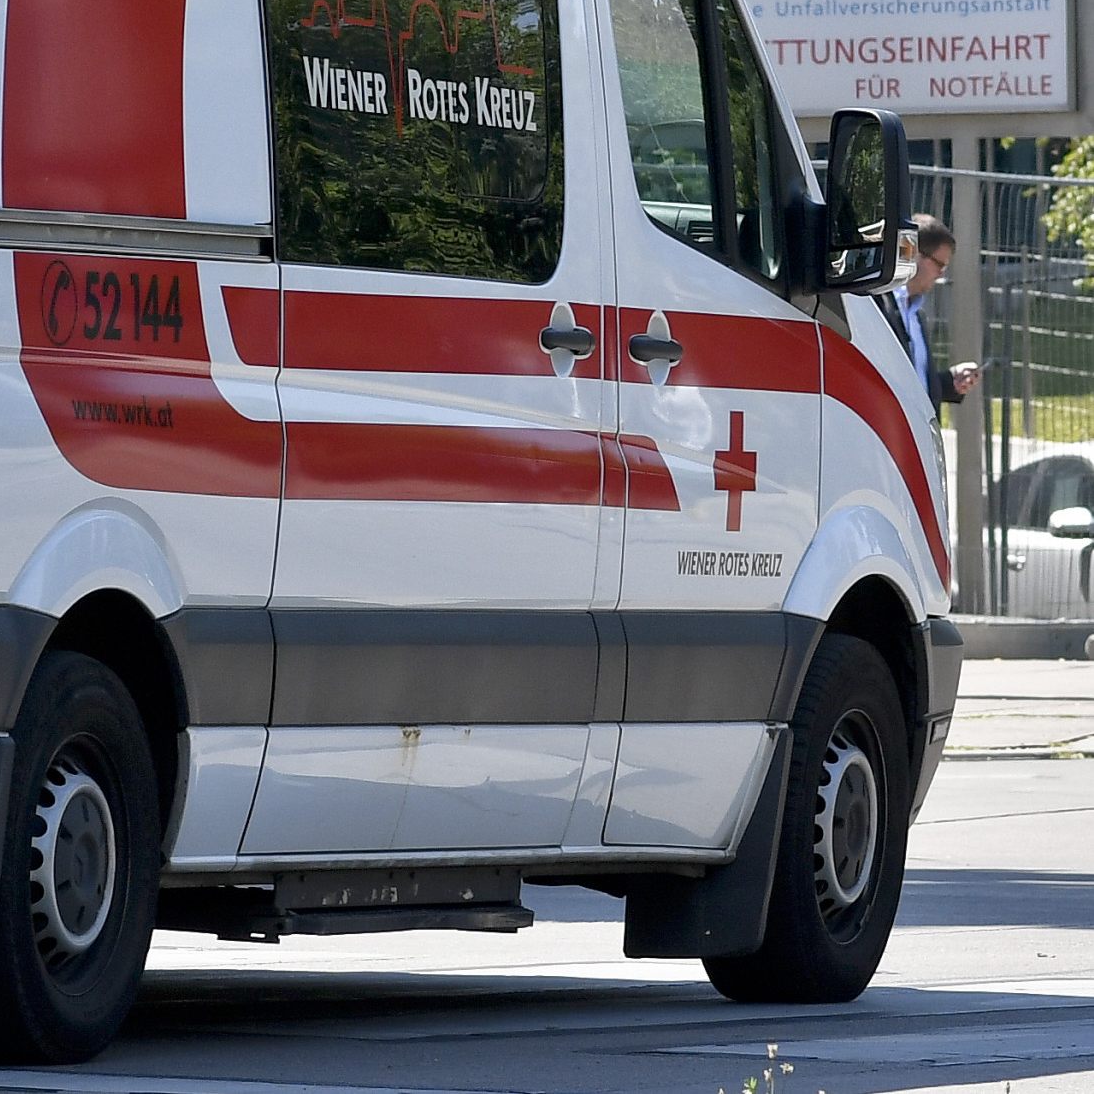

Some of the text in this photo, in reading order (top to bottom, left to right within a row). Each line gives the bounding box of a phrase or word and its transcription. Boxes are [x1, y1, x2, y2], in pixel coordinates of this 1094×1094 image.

[765, 34, 1051, 65] TTUNGSEINFAHRT
[303, 56, 537, 132] WIENER ROTES KREUZ
[855, 71, 1052, 99] FÜR NOTFÄLLE
[83, 271, 184, 343] 52 144
[72, 396, 174, 428] www.wrk.at
[678, 551, 782, 577] WIENER ROTES KREUZ
